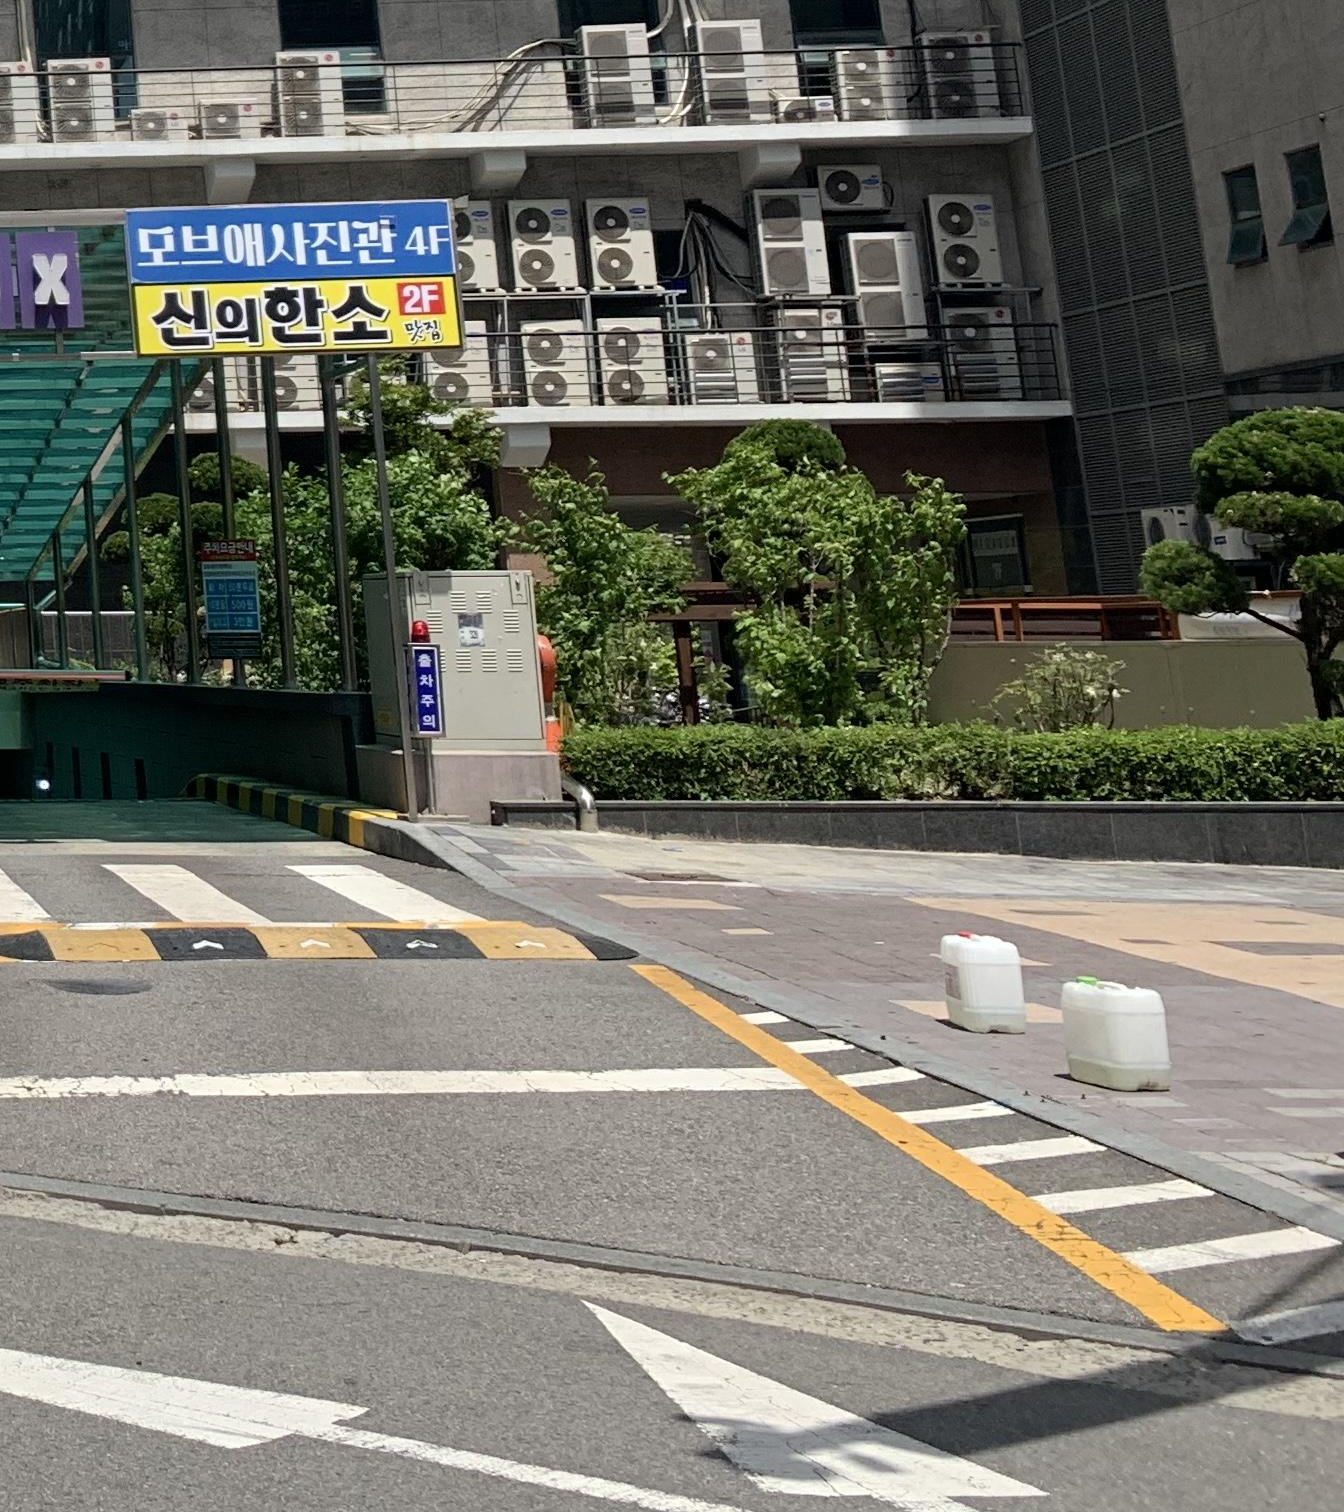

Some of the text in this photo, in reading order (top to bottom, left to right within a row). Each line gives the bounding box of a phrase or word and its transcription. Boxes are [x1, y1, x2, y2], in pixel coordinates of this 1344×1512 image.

[136, 218, 450, 268] 모브애사진관 4F
[151, 285, 392, 348] 신의한소
[402, 284, 440, 314] 2F
[404, 320, 442, 344] 맛집
[418, 653, 436, 729] 출차주의
